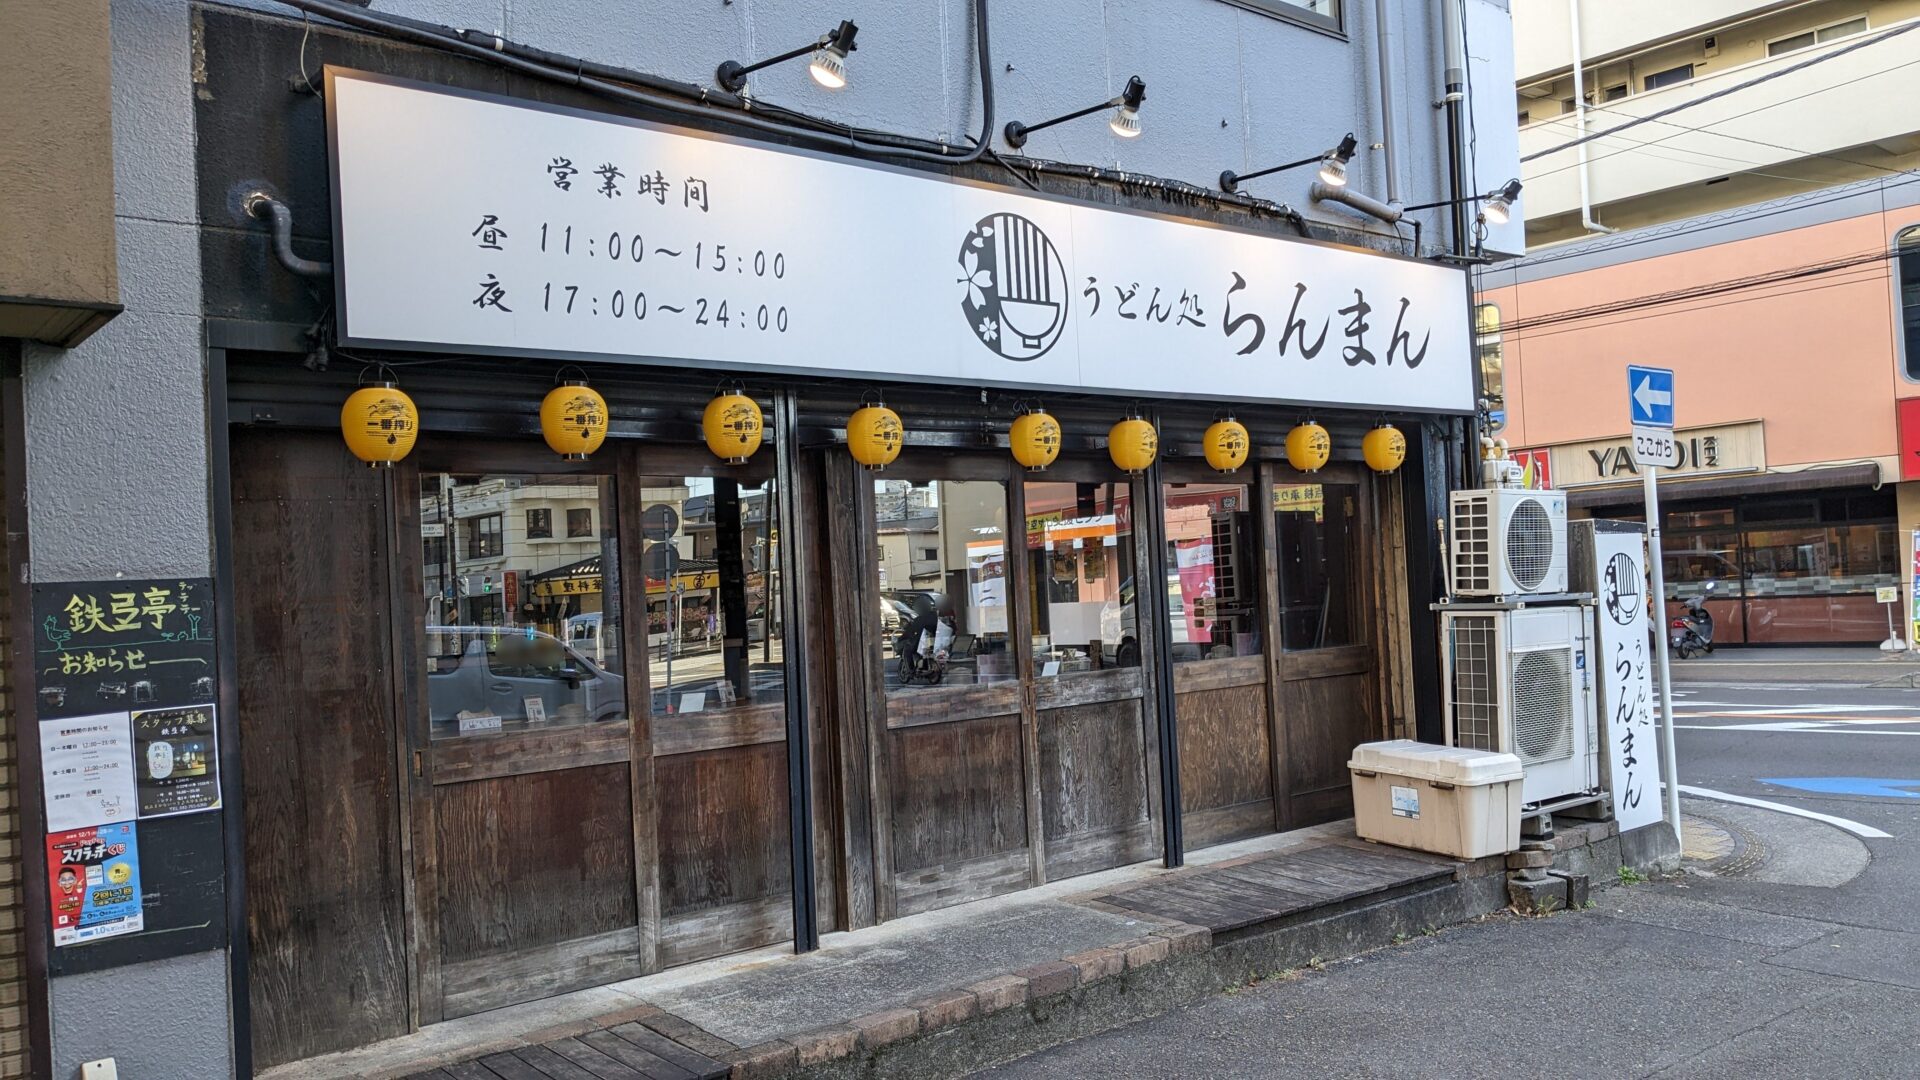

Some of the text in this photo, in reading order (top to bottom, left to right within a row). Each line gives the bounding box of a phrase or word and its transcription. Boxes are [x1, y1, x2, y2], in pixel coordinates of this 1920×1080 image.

[547, 156, 709, 213] 営業時間
[472, 214, 508, 251] 昼
[472, 273, 513, 313] 夜
[1083, 271, 1431, 369] うどん処 らんまん
[1636, 436, 1673, 458] ここから
[1703, 436, 1719, 466] KEN
[58, 649, 147, 675] お知らせ
[1634, 639, 1650, 726] うどん処
[140, 713, 207, 729] スタッフ募集
[1615, 641, 1643, 811] らんまん
